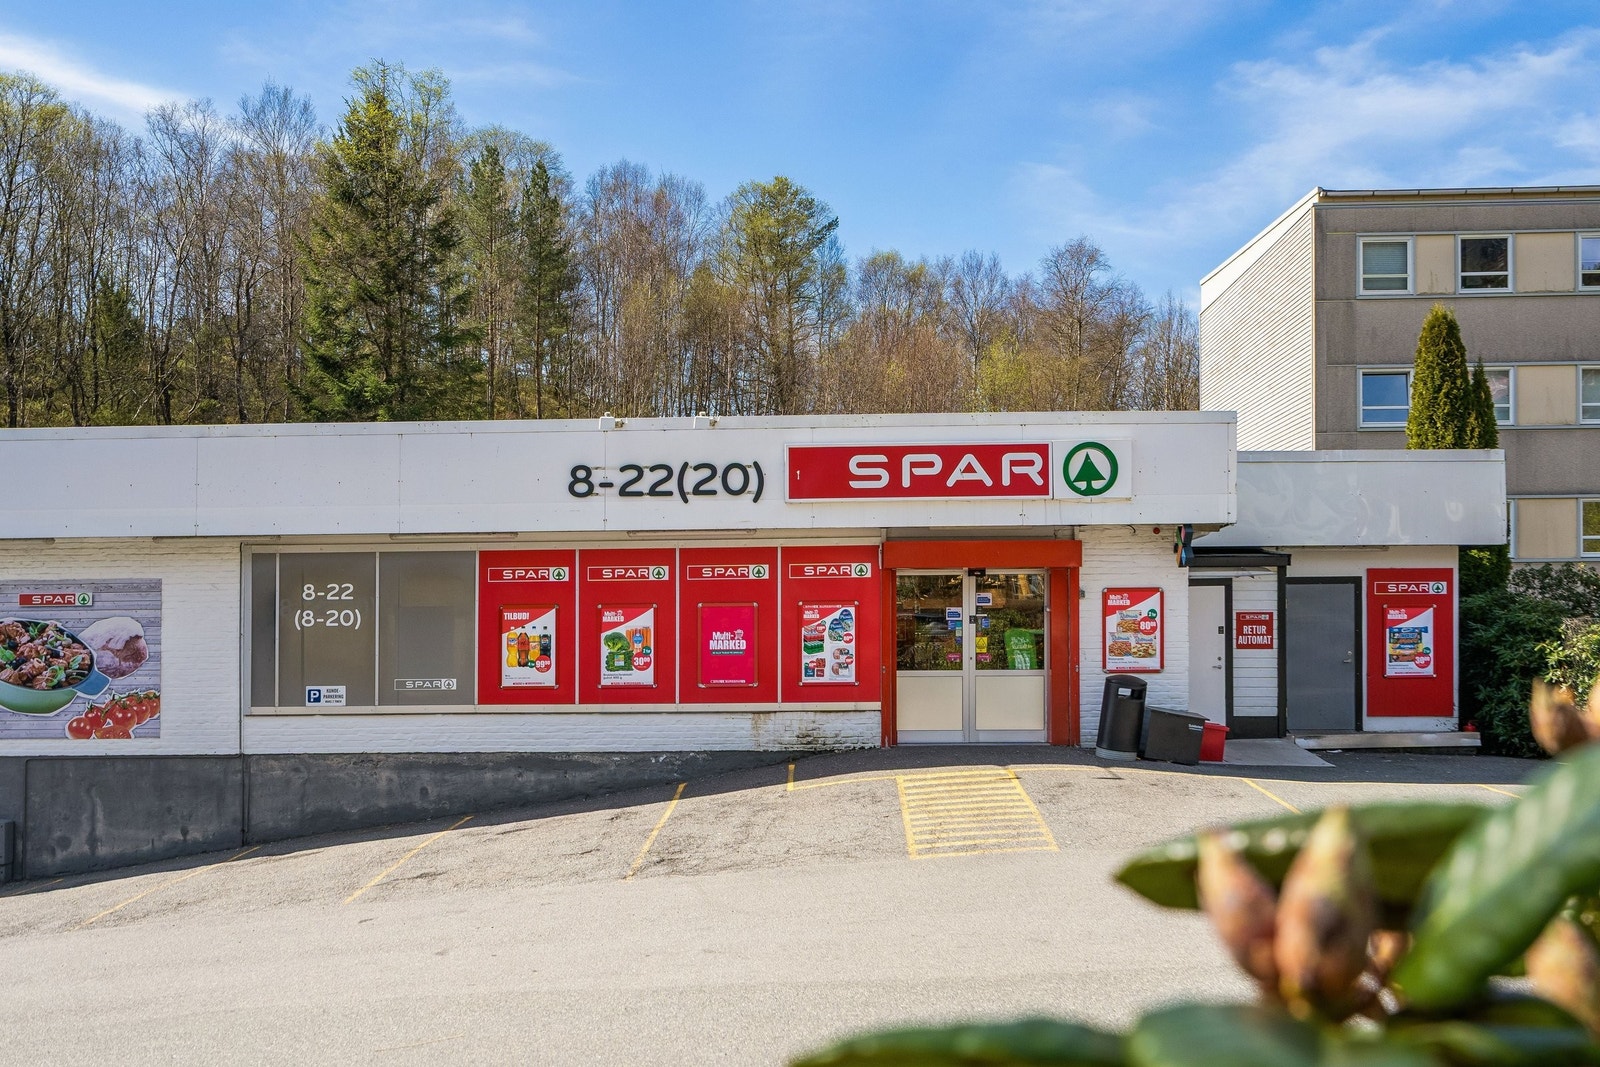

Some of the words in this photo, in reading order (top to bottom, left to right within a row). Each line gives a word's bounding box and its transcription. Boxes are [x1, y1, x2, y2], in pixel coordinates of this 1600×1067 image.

[849, 452, 1044, 489] SPAR
[568, 461, 764, 503] 8-22(20)
[503, 569, 549, 579] SPAR
[602, 568, 649, 578] SPAR
[702, 567, 749, 577] SPAR
[804, 566, 851, 576] SPAR
[302, 583, 354, 601] 8-22
[1387, 583, 1429, 592] SPAR
[32, 595, 75, 604] SPAR
[294, 608, 361, 631] (8-20)
[503, 612, 530, 620] TILBUD!
[1243, 625, 1267, 635] RETUR
[712, 631, 735, 640] Multi-
[1238, 635, 1272, 645] AUTOMAT
[709, 640, 747, 650] MARKED
[405, 680, 441, 689] SPAR
[310, 690, 320, 702] P
